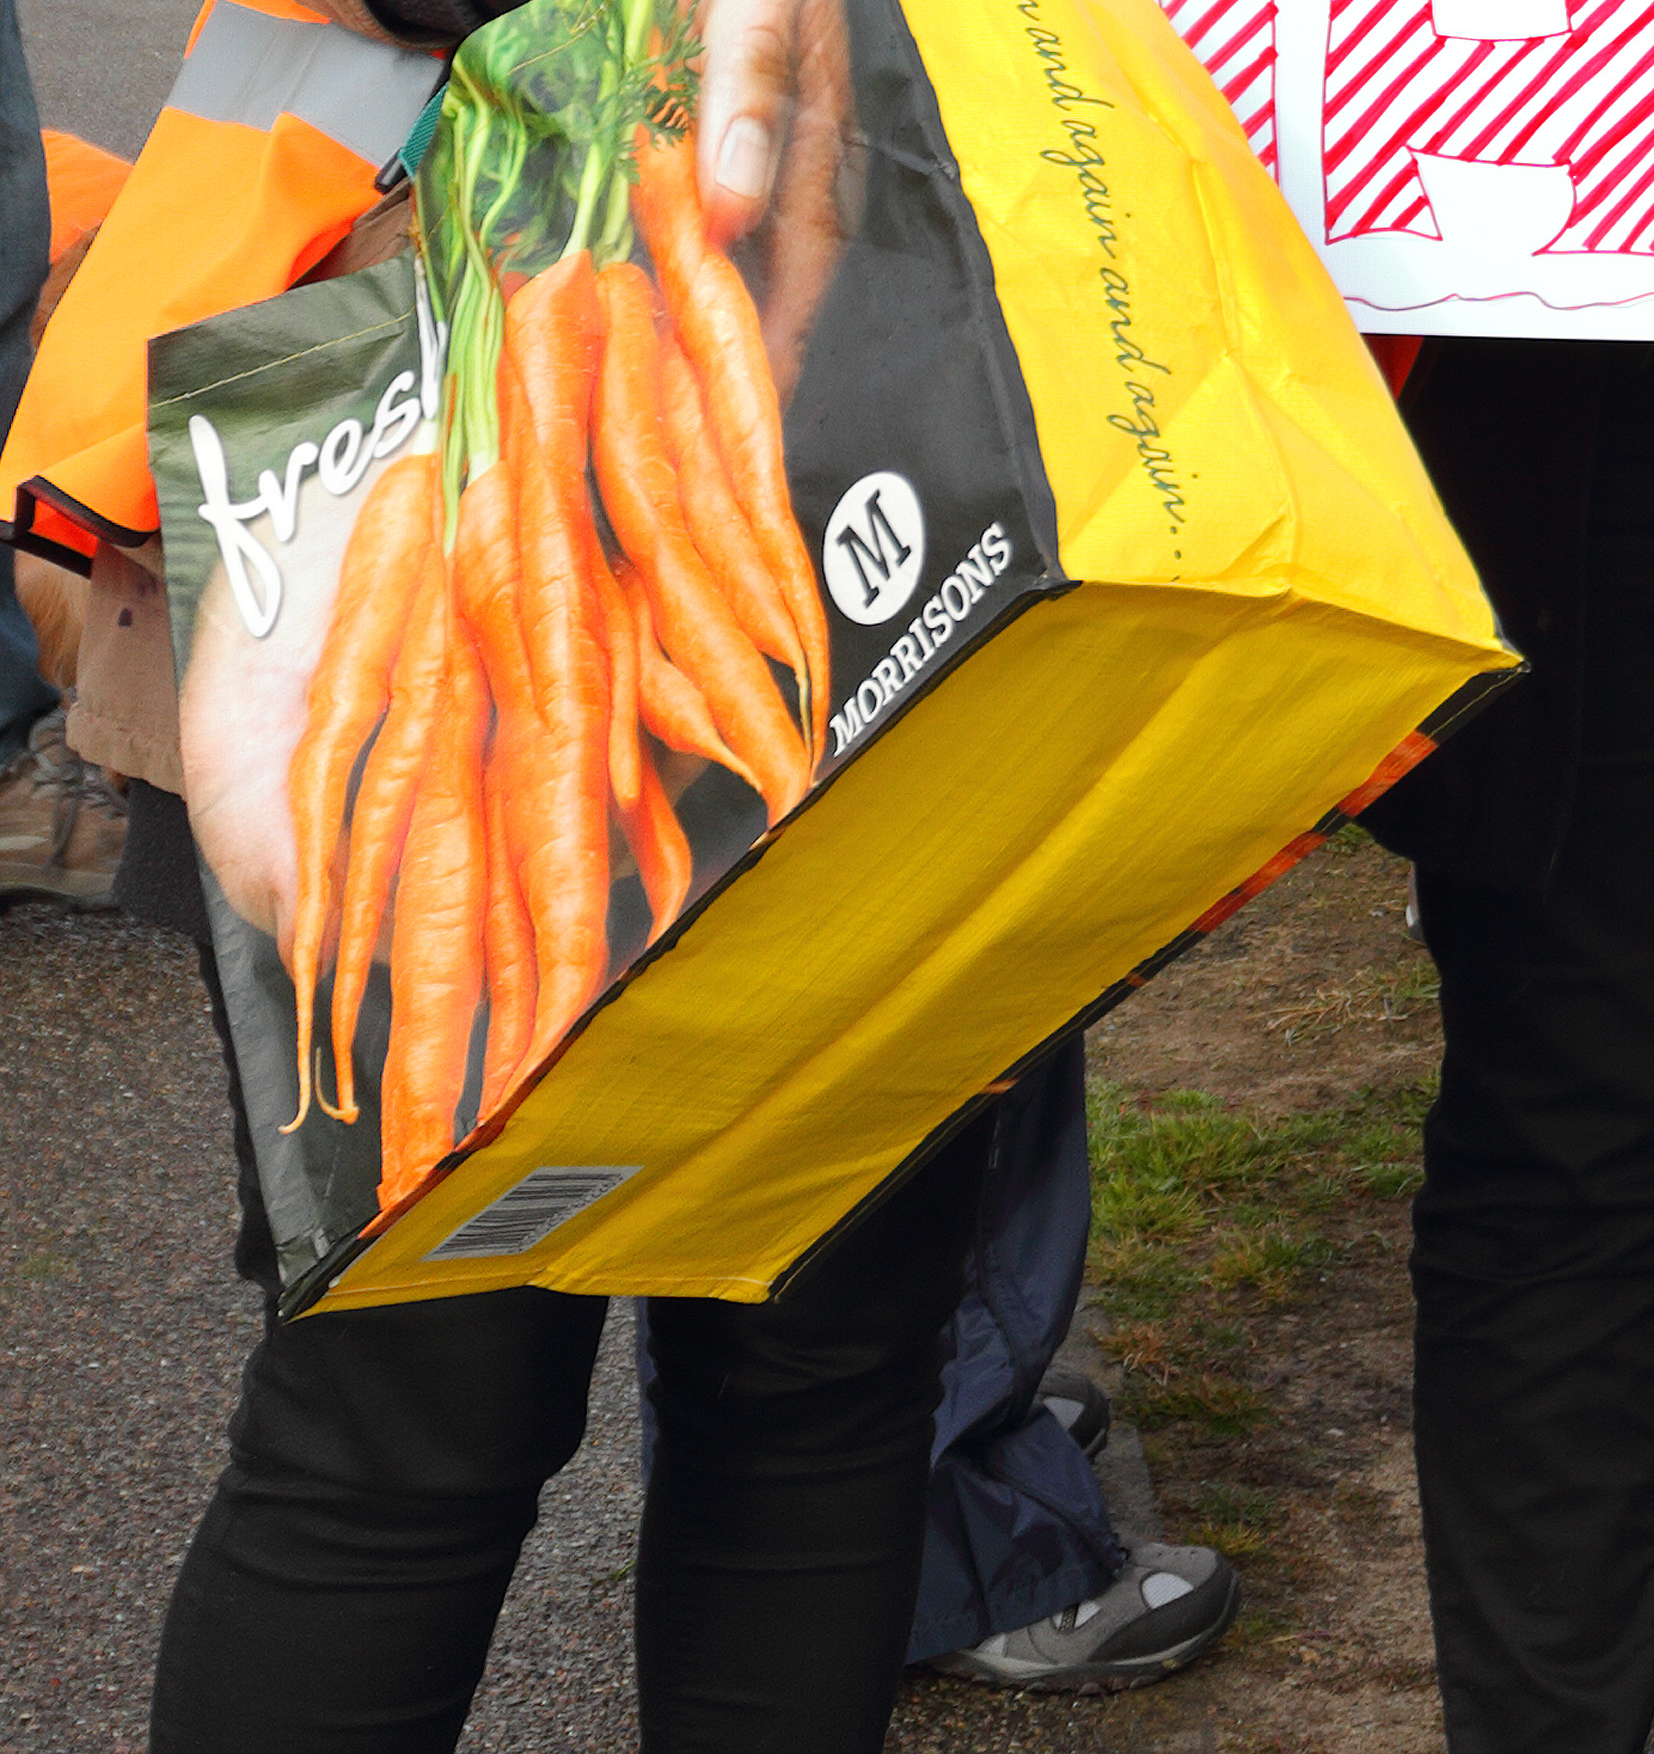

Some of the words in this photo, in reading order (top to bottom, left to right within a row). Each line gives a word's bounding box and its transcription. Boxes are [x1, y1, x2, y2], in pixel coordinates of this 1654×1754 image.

[1025, 27, 1116, 112] and
[1039, 119, 1131, 260] again
[1099, 266, 1172, 373] and
[834, 487, 913, 611] M
[828, 520, 1014, 758] MORRISONS
